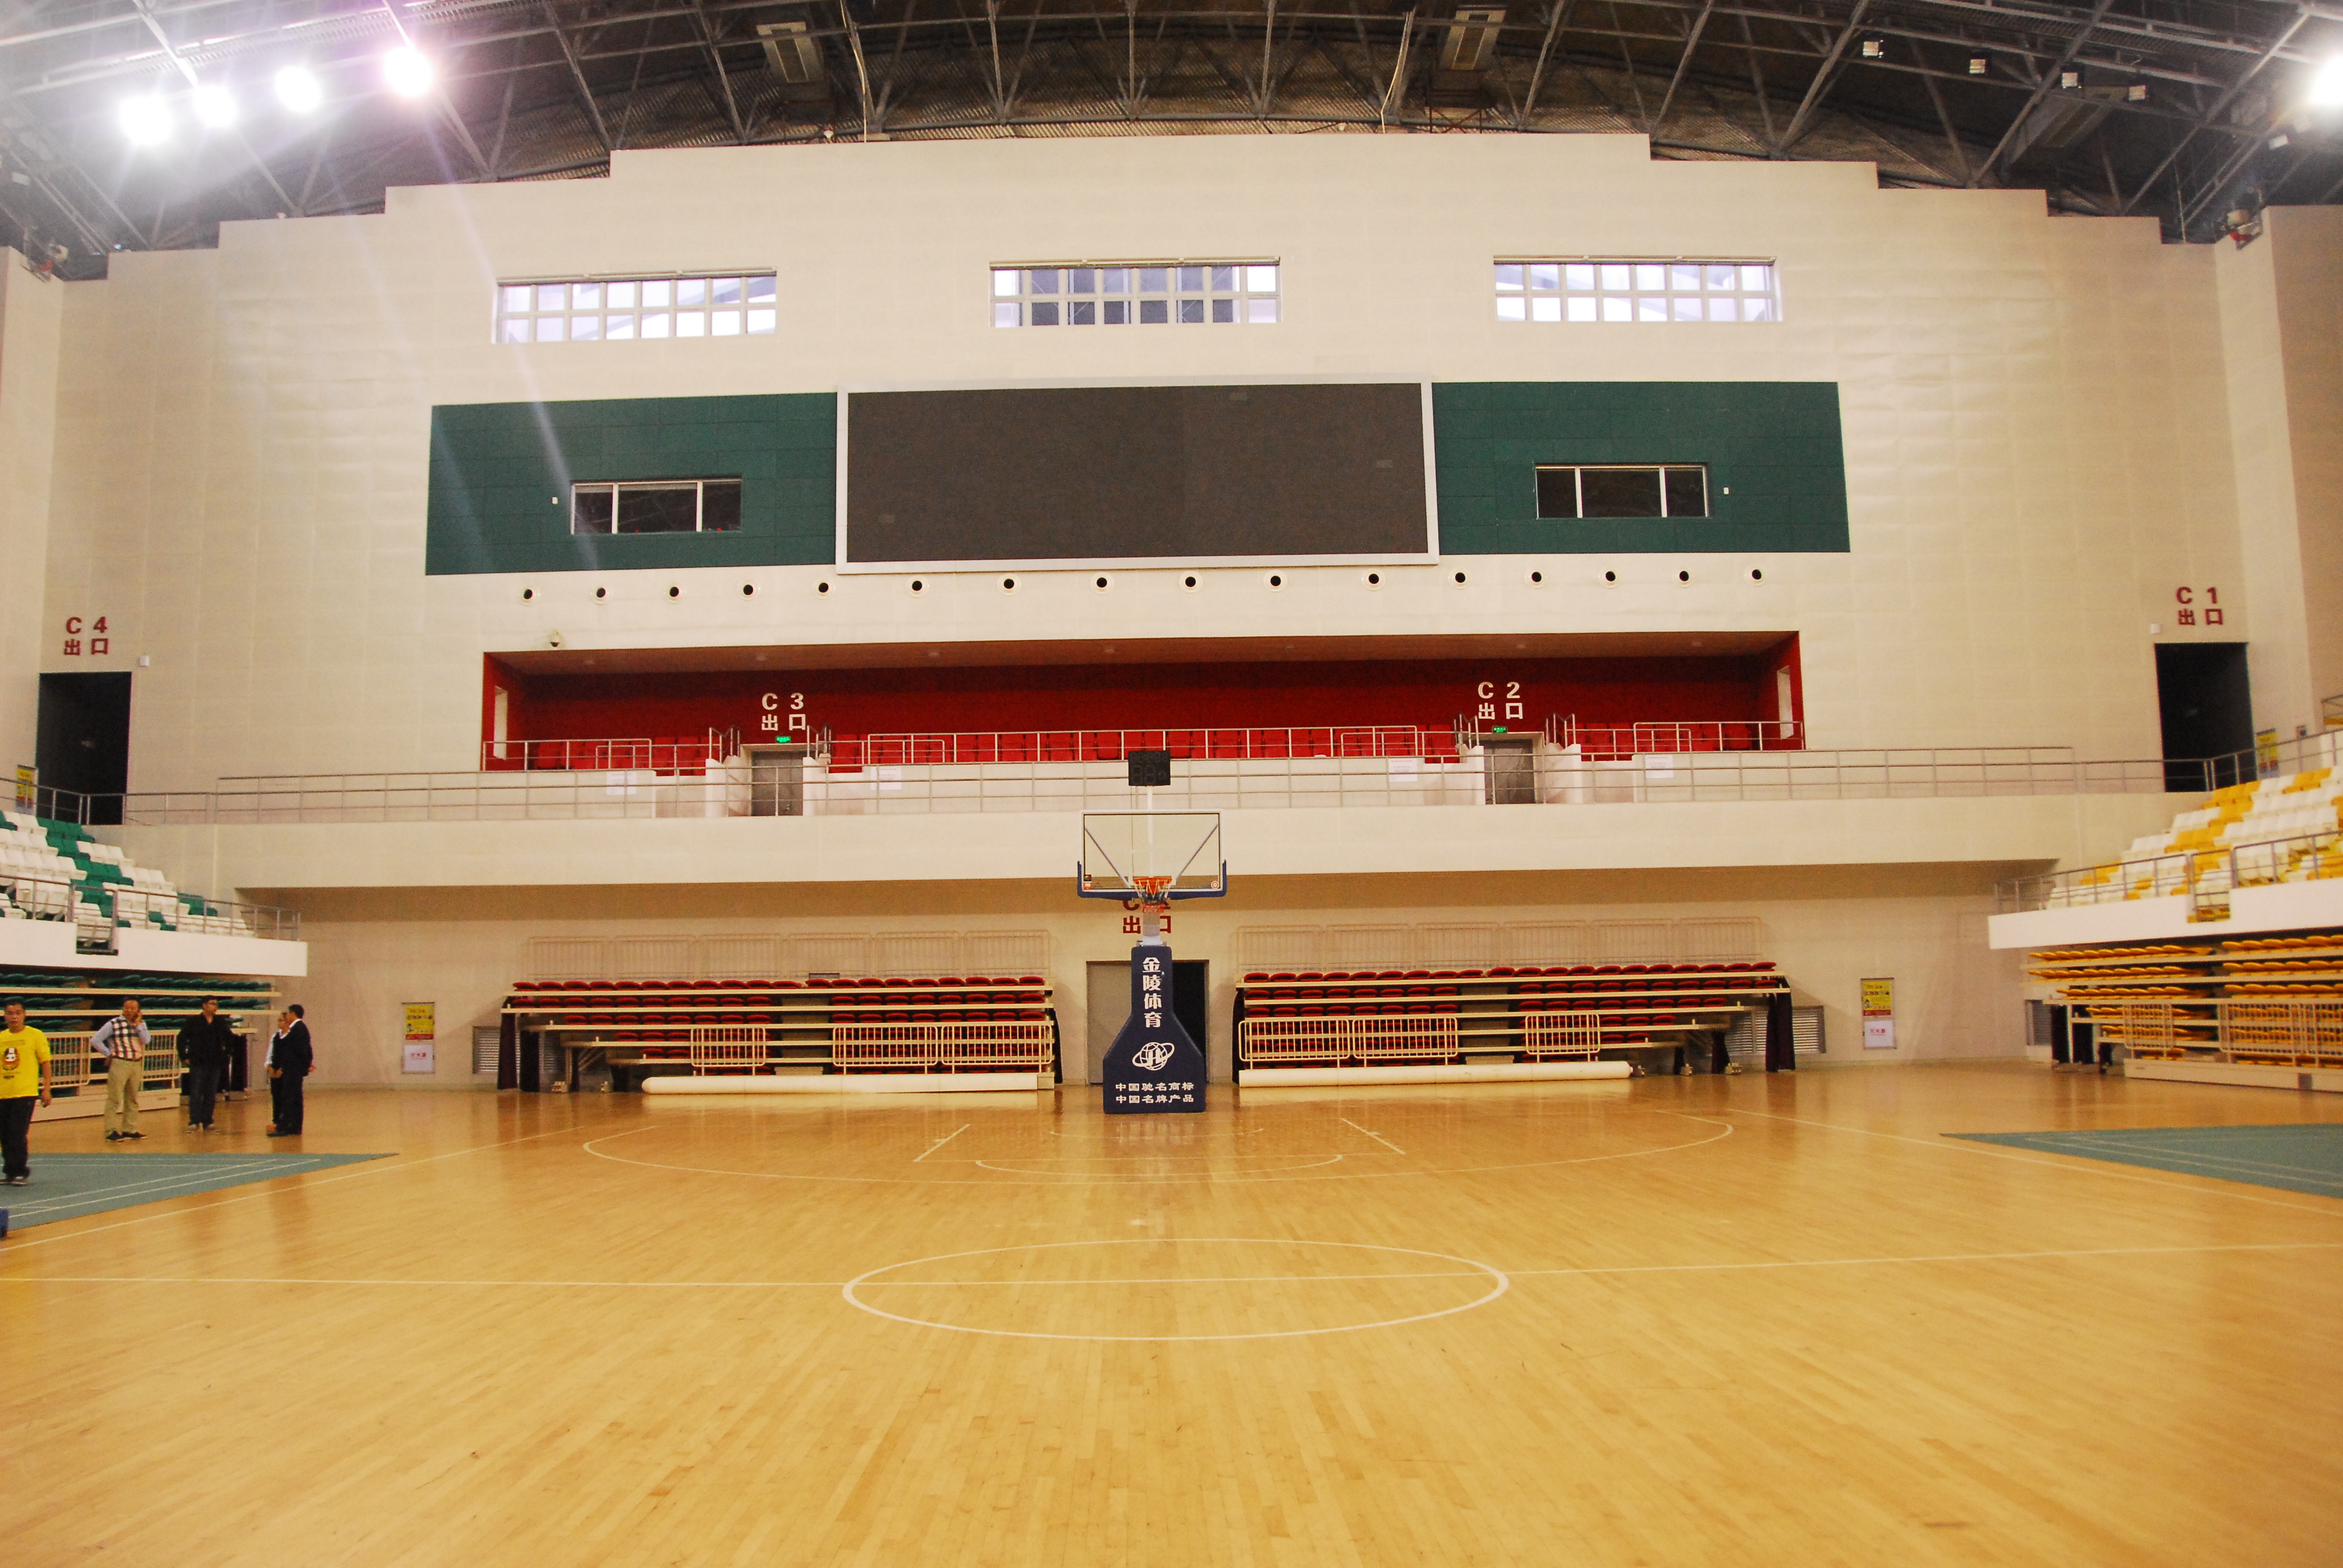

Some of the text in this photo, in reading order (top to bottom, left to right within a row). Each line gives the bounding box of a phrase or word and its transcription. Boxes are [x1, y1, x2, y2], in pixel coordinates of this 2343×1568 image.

[2178, 608, 2223, 626] 出口
[64, 638, 109, 656] 出口
[1478, 702, 1523, 720] 出口
[761, 714, 806, 731] 出口
[1142, 957, 1162, 1028] 金陵体育
[1115, 1082, 1194, 1091] 中国驰名商标
[1115, 1094, 1194, 1104] 中国名牌产品
